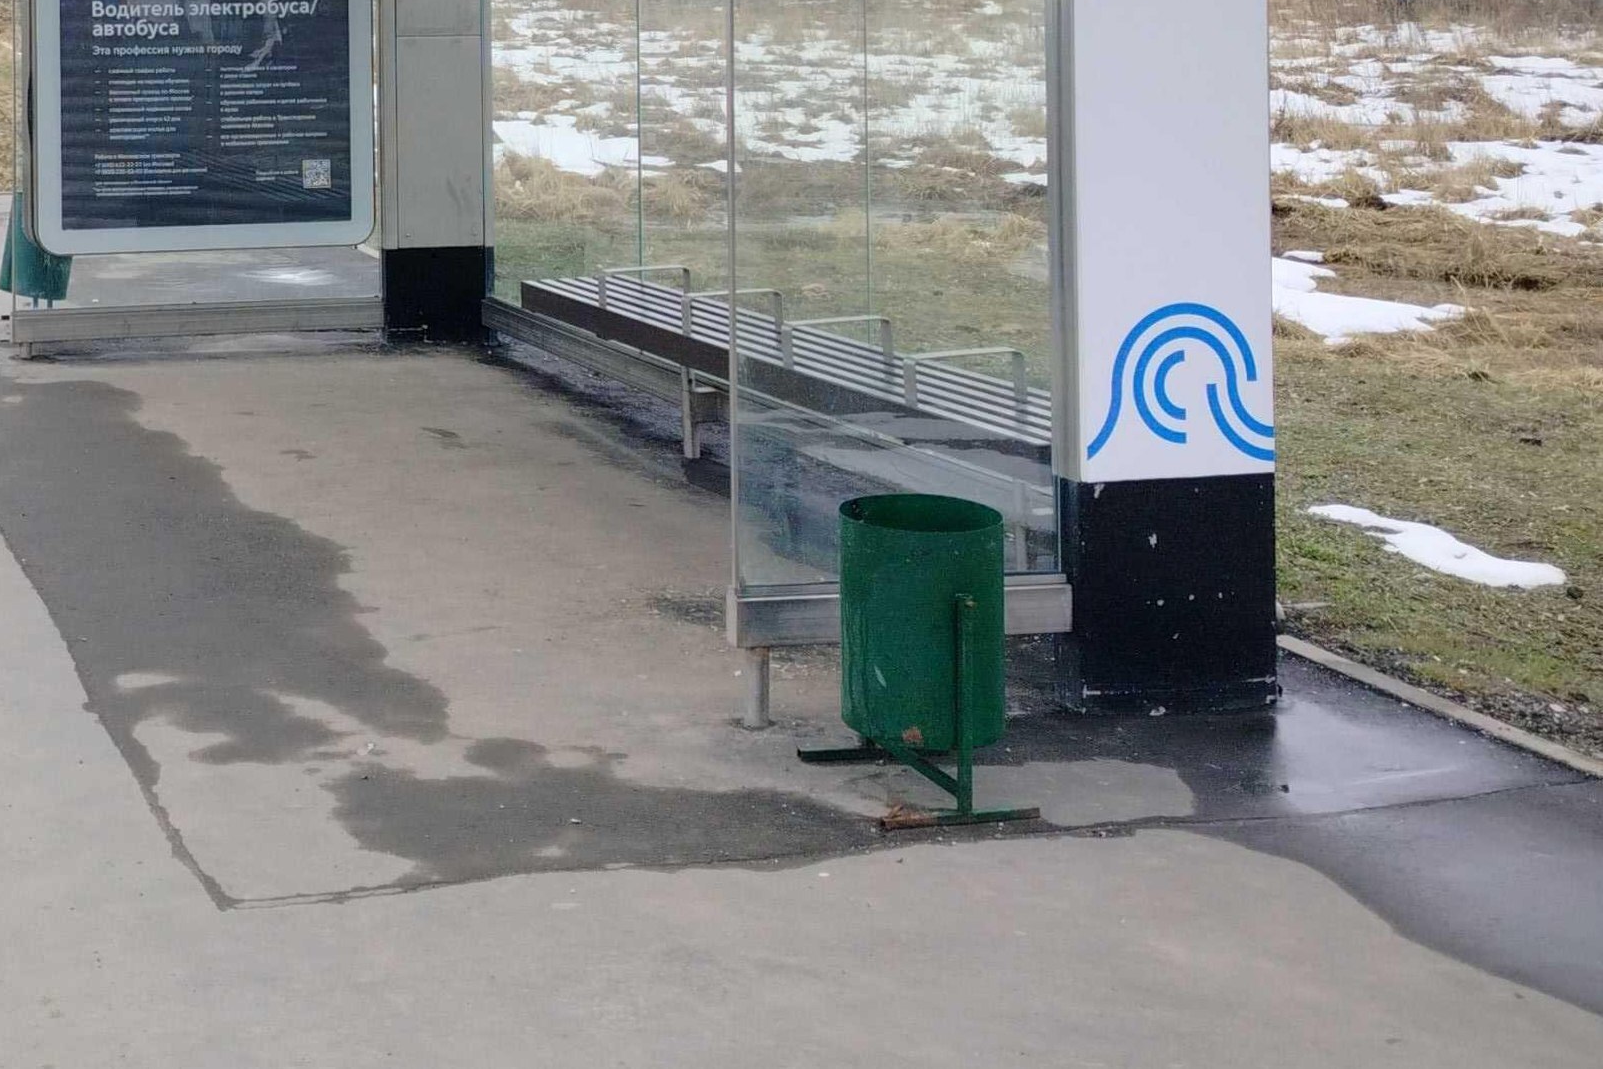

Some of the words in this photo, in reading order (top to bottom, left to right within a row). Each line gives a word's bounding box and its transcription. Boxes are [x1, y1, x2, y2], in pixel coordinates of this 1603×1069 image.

[92, 1, 184, 19] Водитель
[92, 19, 180, 39] автобуса
[92, 46, 111, 56] Эта
[113, 45, 170, 57] профессия
[172, 45, 205, 56] нужна
[206, 44, 243, 55] городу
